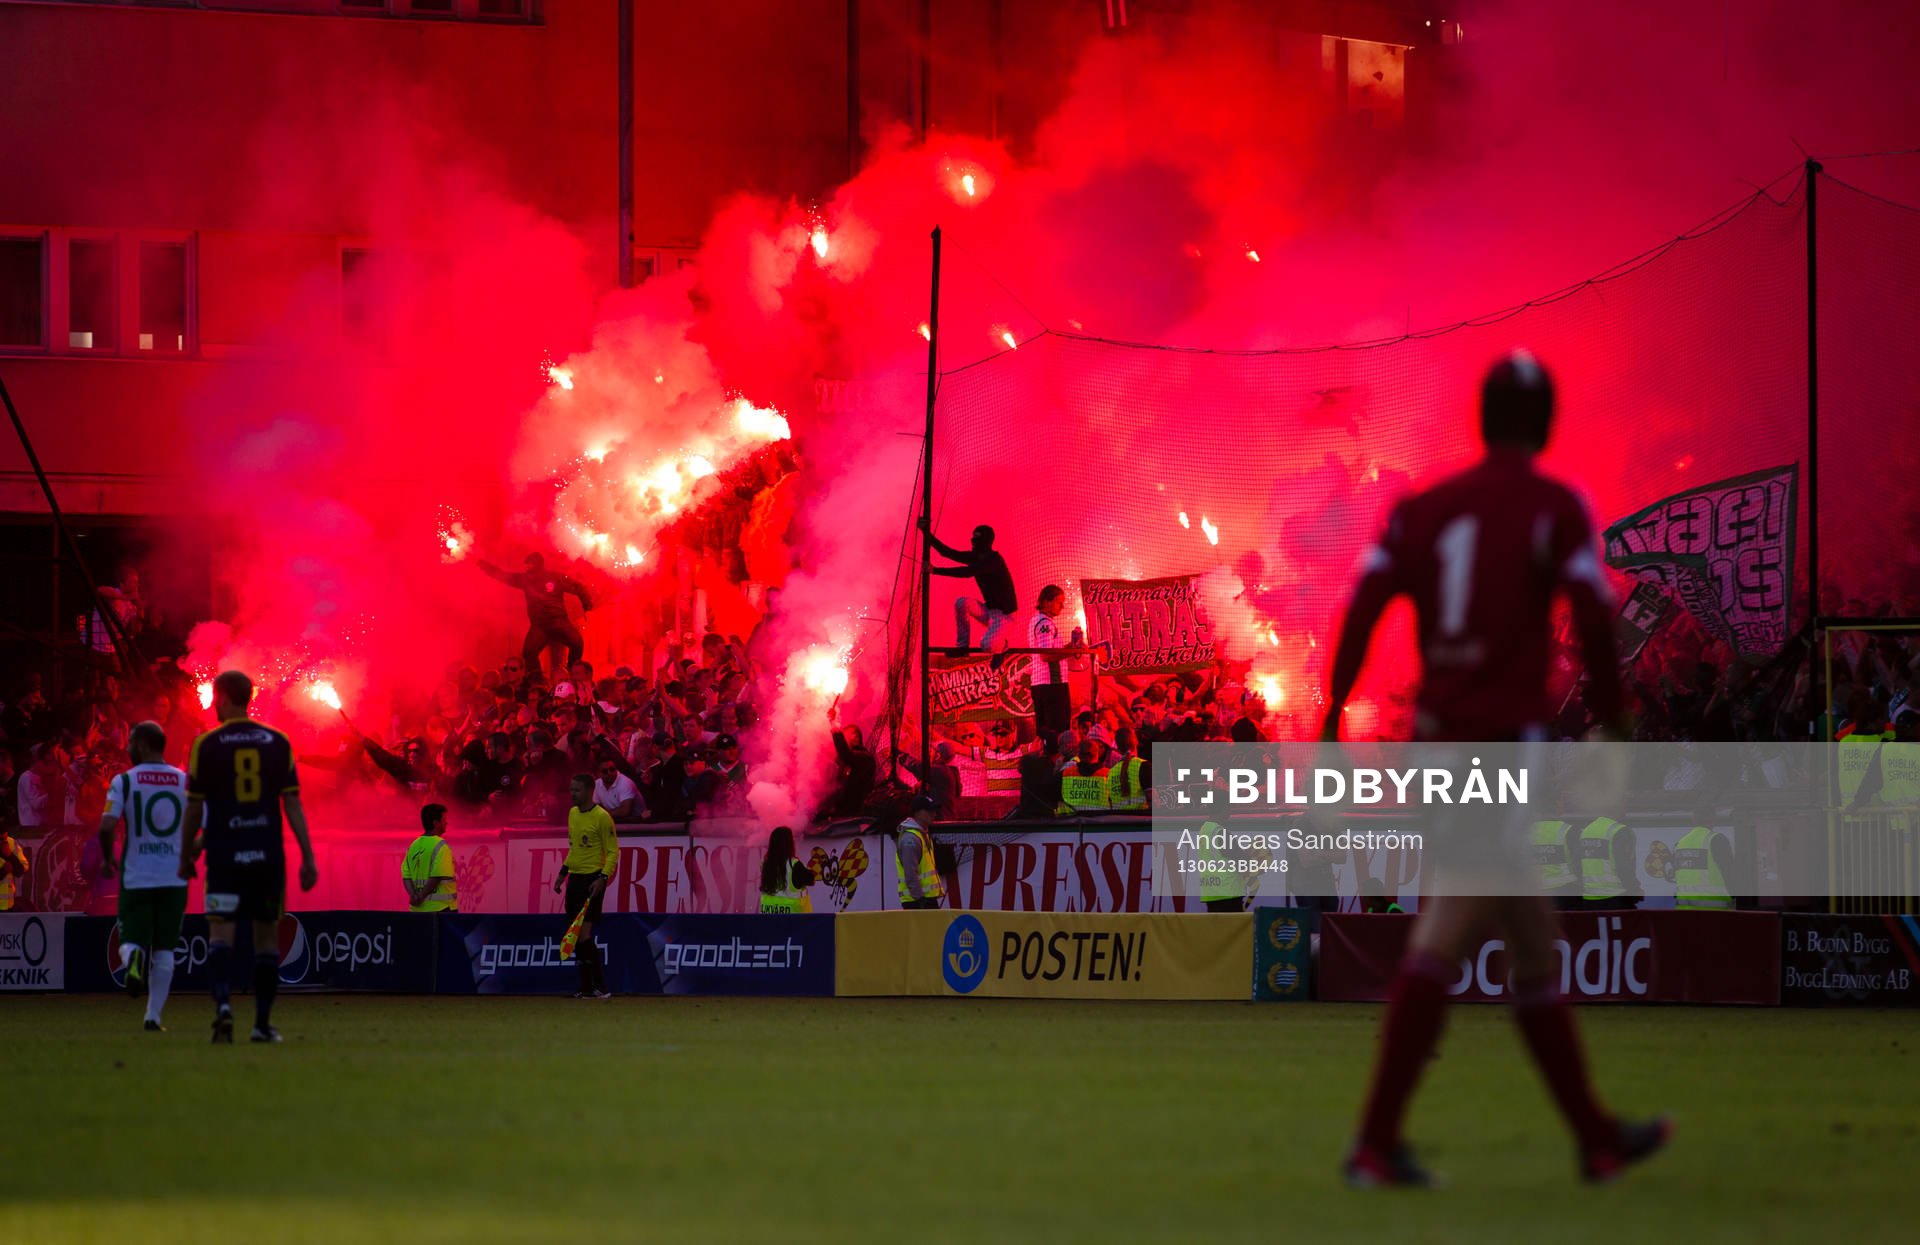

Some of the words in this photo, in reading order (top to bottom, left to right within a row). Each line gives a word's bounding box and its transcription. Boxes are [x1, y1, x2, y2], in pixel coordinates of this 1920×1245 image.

[1434, 512, 1481, 636] 1
[1087, 598, 1216, 652] ULTRAS
[1110, 643, 1216, 669] Stockholm
[939, 677, 1001, 711] ULTRAS
[233, 748, 262, 802] 8
[1073, 779, 1099, 789] PUBLIK
[133, 790, 181, 837] 10
[1070, 790, 1100, 800] SERVICE
[315, 925, 392, 972] pepsi
[664, 936, 803, 975] goodtech
[998, 931, 1146, 982] POSTEN!
[1786, 930, 1803, 952] B.
[1884, 968, 1911, 990] AB
